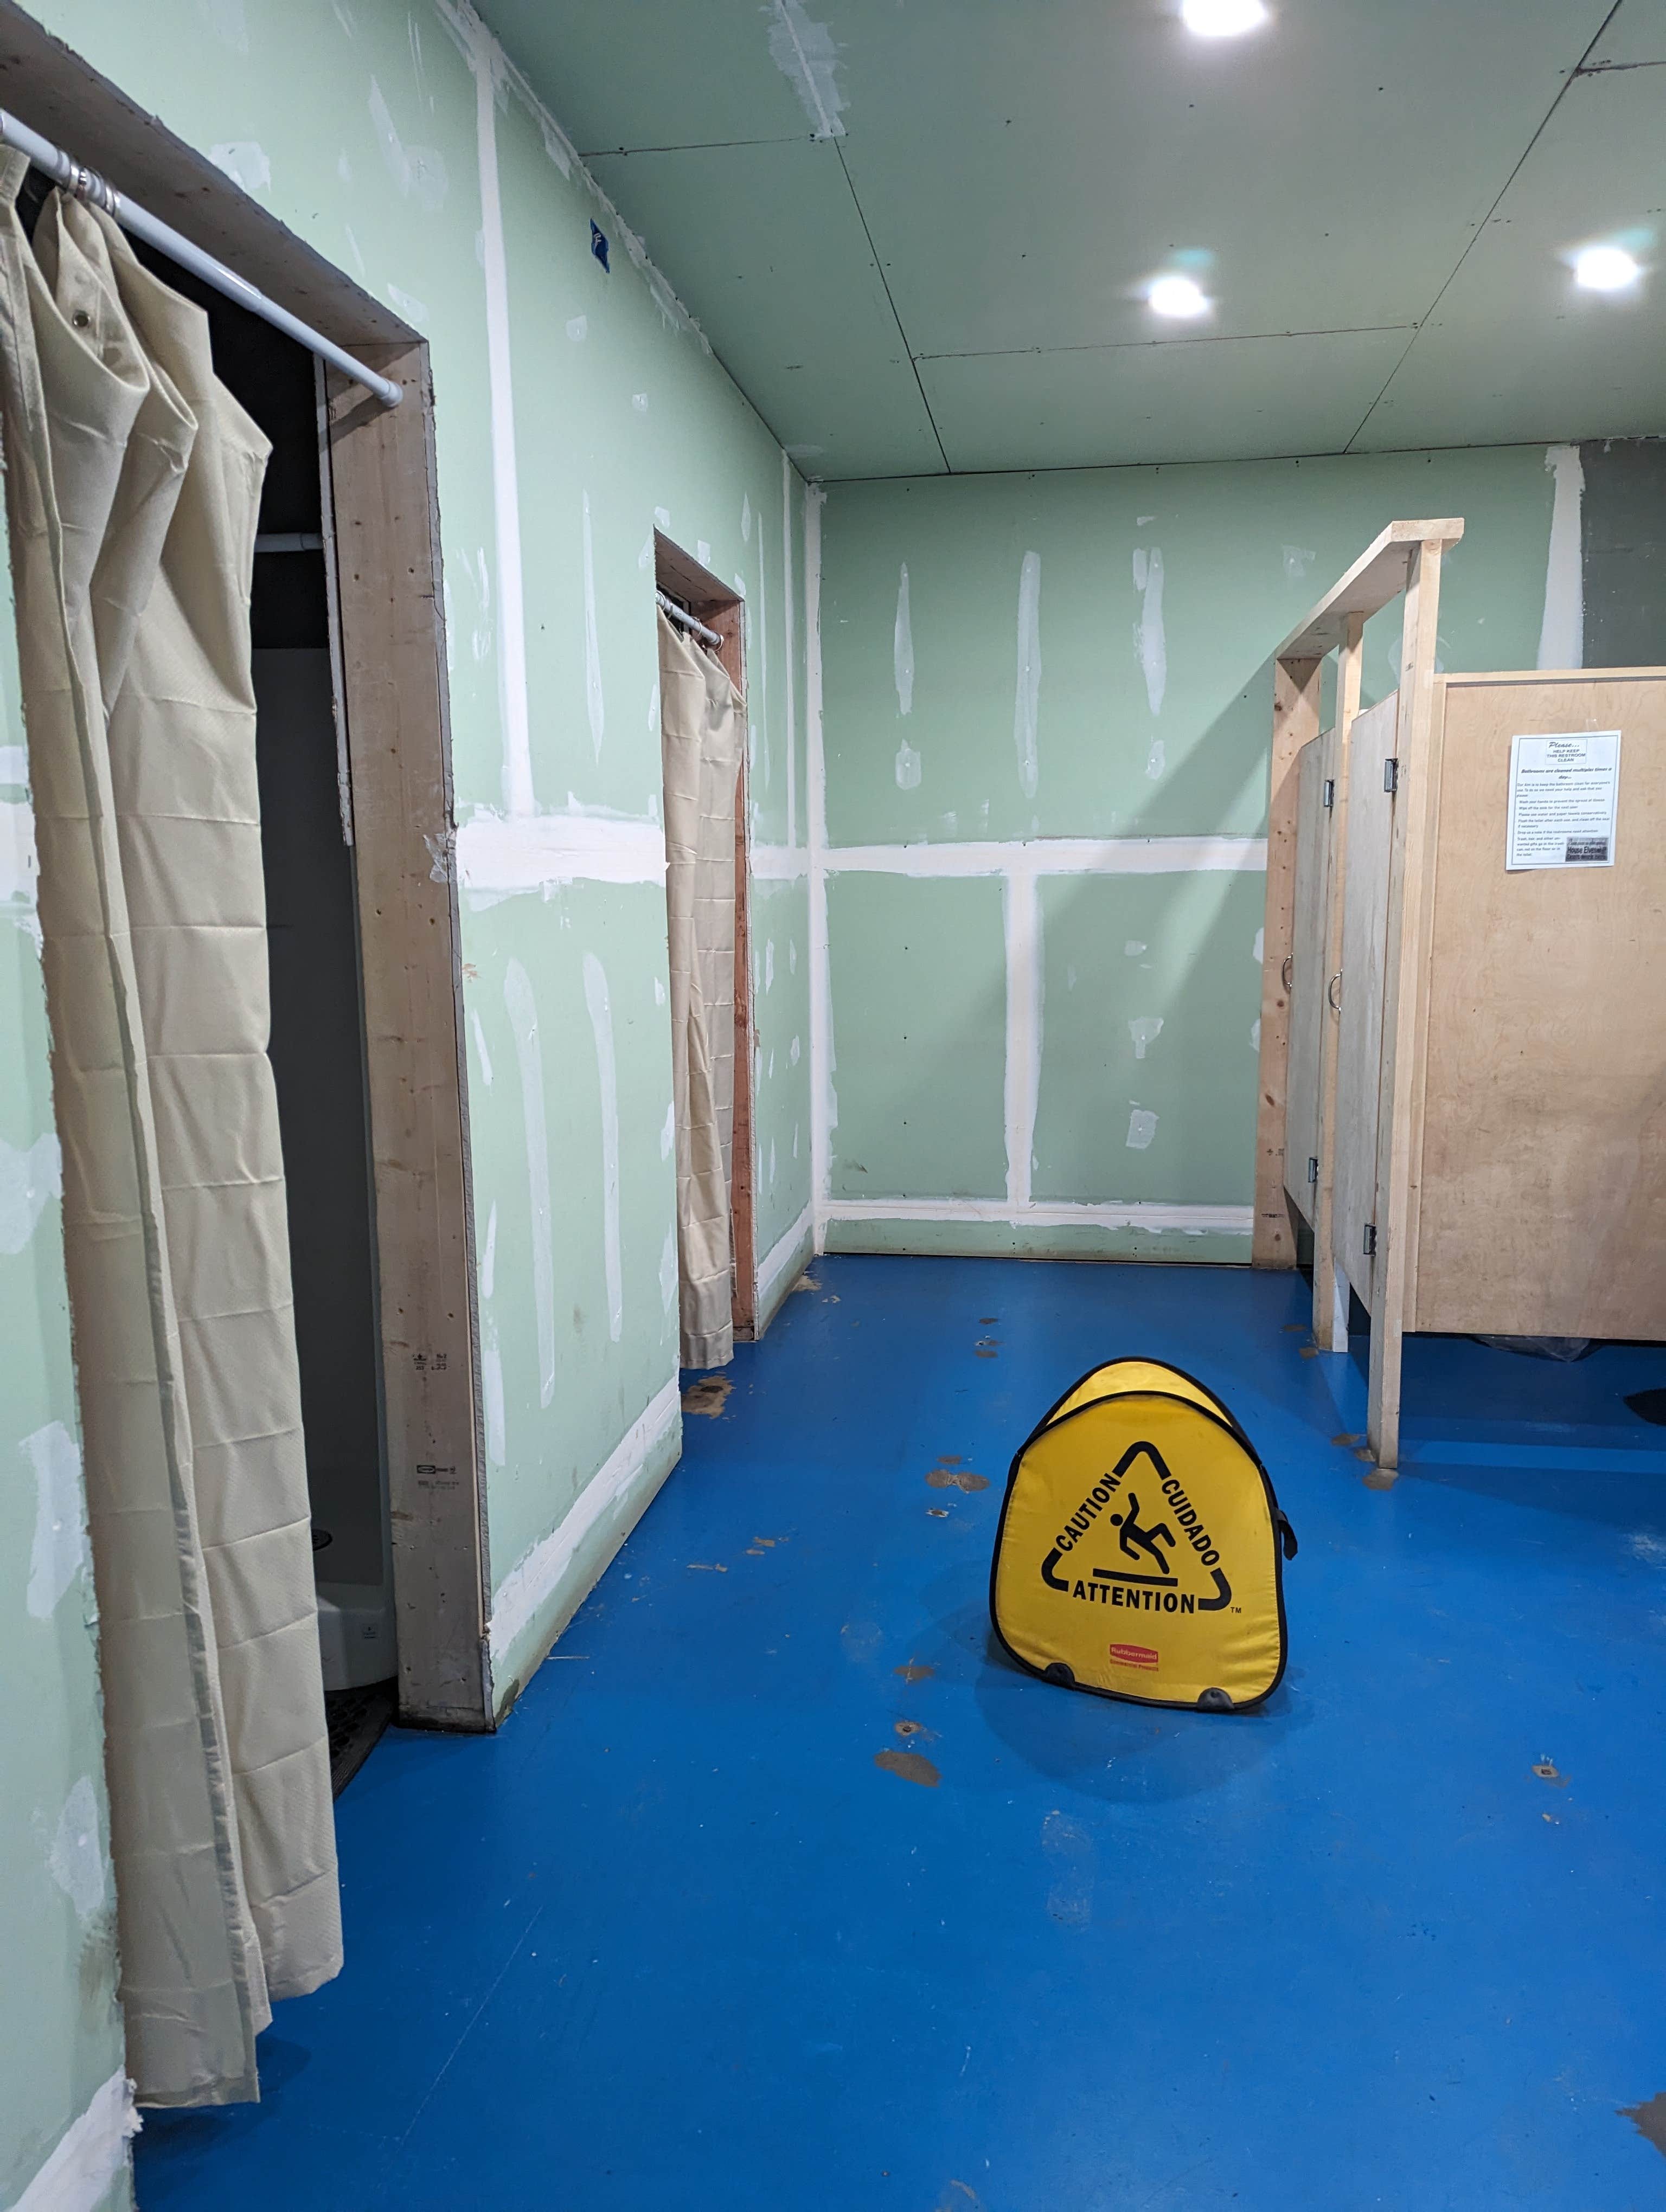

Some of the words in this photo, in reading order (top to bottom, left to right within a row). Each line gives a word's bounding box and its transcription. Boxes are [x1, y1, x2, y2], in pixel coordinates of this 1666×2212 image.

[1055, 1472, 1121, 1552] CAUTION
[1161, 1479, 1220, 1567] CUIDADO
[1073, 1580, 1195, 1614] ATTENTION
[1111, 1647, 1157, 1660] Rubbermaid
